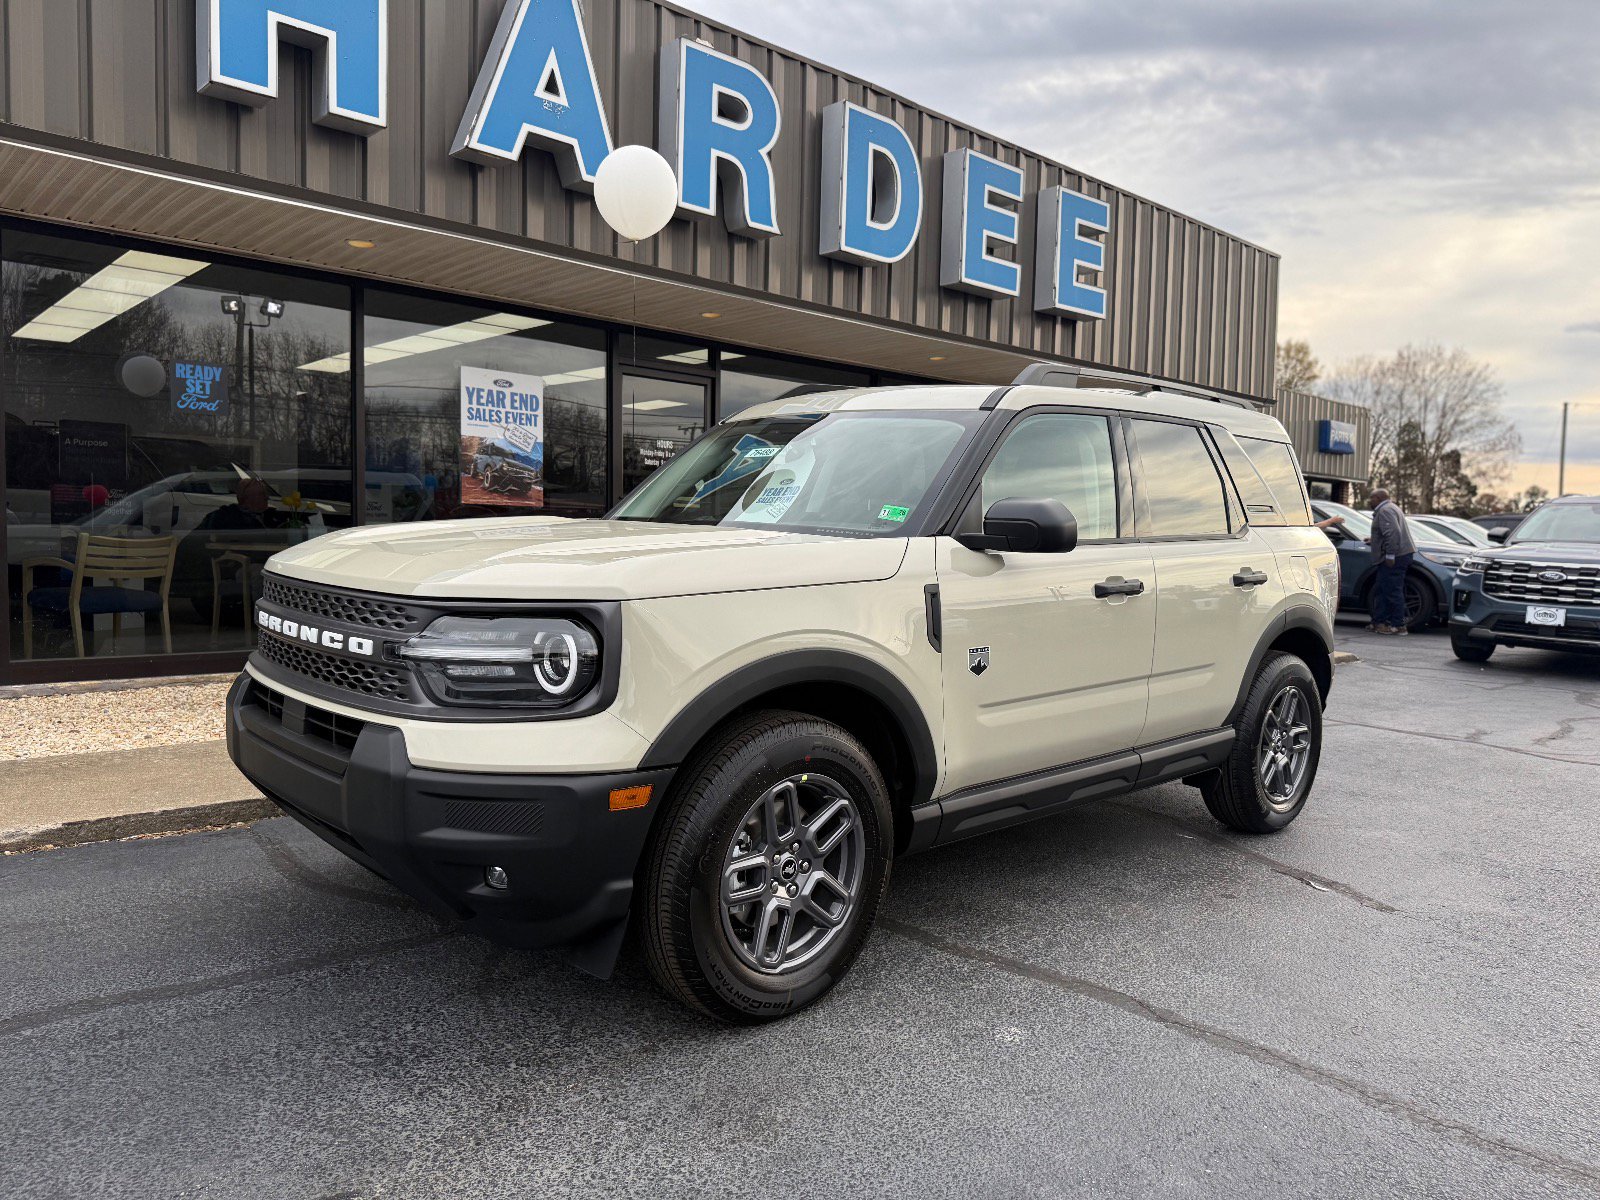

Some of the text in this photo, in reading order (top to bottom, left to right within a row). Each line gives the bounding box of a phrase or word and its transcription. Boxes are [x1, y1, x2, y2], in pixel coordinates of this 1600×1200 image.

[176, 363, 222, 381] READY
[186, 379, 212, 395] SET
[177, 393, 221, 411] Ford
[465, 386, 540, 412] YEAR END
[467, 407, 539, 427] SALES EVENT
[73, 438, 109, 448] Purpose
[656, 440, 673, 449] HOURS
[763, 486, 800, 496] YEAR END
[258, 610, 374, 656] BRONCO
